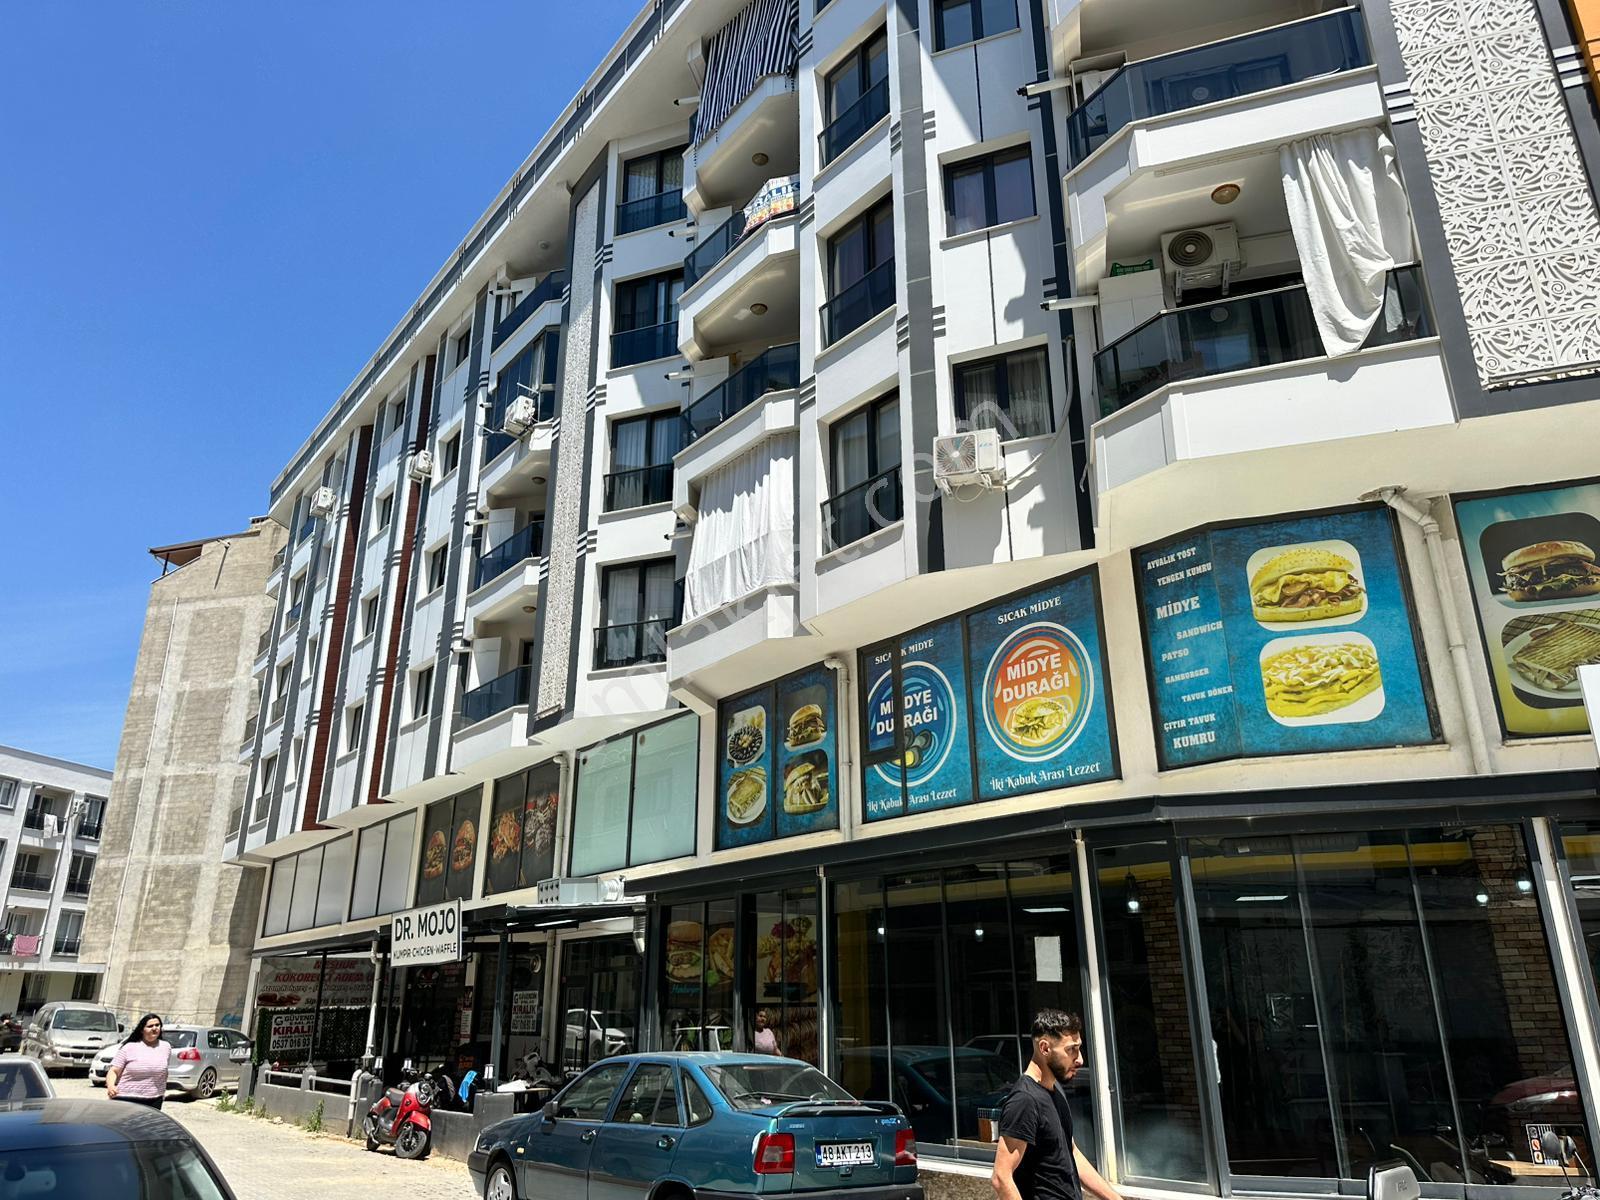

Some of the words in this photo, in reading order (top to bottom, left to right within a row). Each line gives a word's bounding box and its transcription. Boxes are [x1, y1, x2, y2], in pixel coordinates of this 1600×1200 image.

[1147, 554, 1176, 570] AYVALIK
[1176, 547, 1196, 560] TOST
[1157, 571, 1185, 587] YENGEN
[1186, 562, 1212, 577] KUMRU
[997, 608, 1027, 625] SICAK
[1029, 596, 1062, 614] MİDYE
[1156, 596, 1200, 619] MİDYE
[908, 638, 934, 654] MİDYE
[1006, 652, 1061, 682] MİDYE
[1165, 667, 1209, 684] HAMBURGER
[1002, 671, 1070, 704] DURAĞI
[1181, 691, 1206, 702] TAVUK
[876, 705, 938, 736] DURAĞI
[1163, 719, 1186, 732] ÇITIR
[1188, 713, 1216, 725] TAVUK
[1173, 731, 1216, 749] KUMRU
[1005, 772, 1039, 789] Kabuk
[1039, 769, 1065, 781] Arası
[1066, 762, 1100, 777] Lezzet
[908, 794, 930, 805] Arası
[930, 788, 957, 801] Lezzet
[394, 916, 414, 942] DR.
[417, 907, 456, 938] MOJO
[822, 1146, 834, 1160] 48
[836, 1145, 853, 1160] AKT
[854, 1144, 872, 1159] 213
